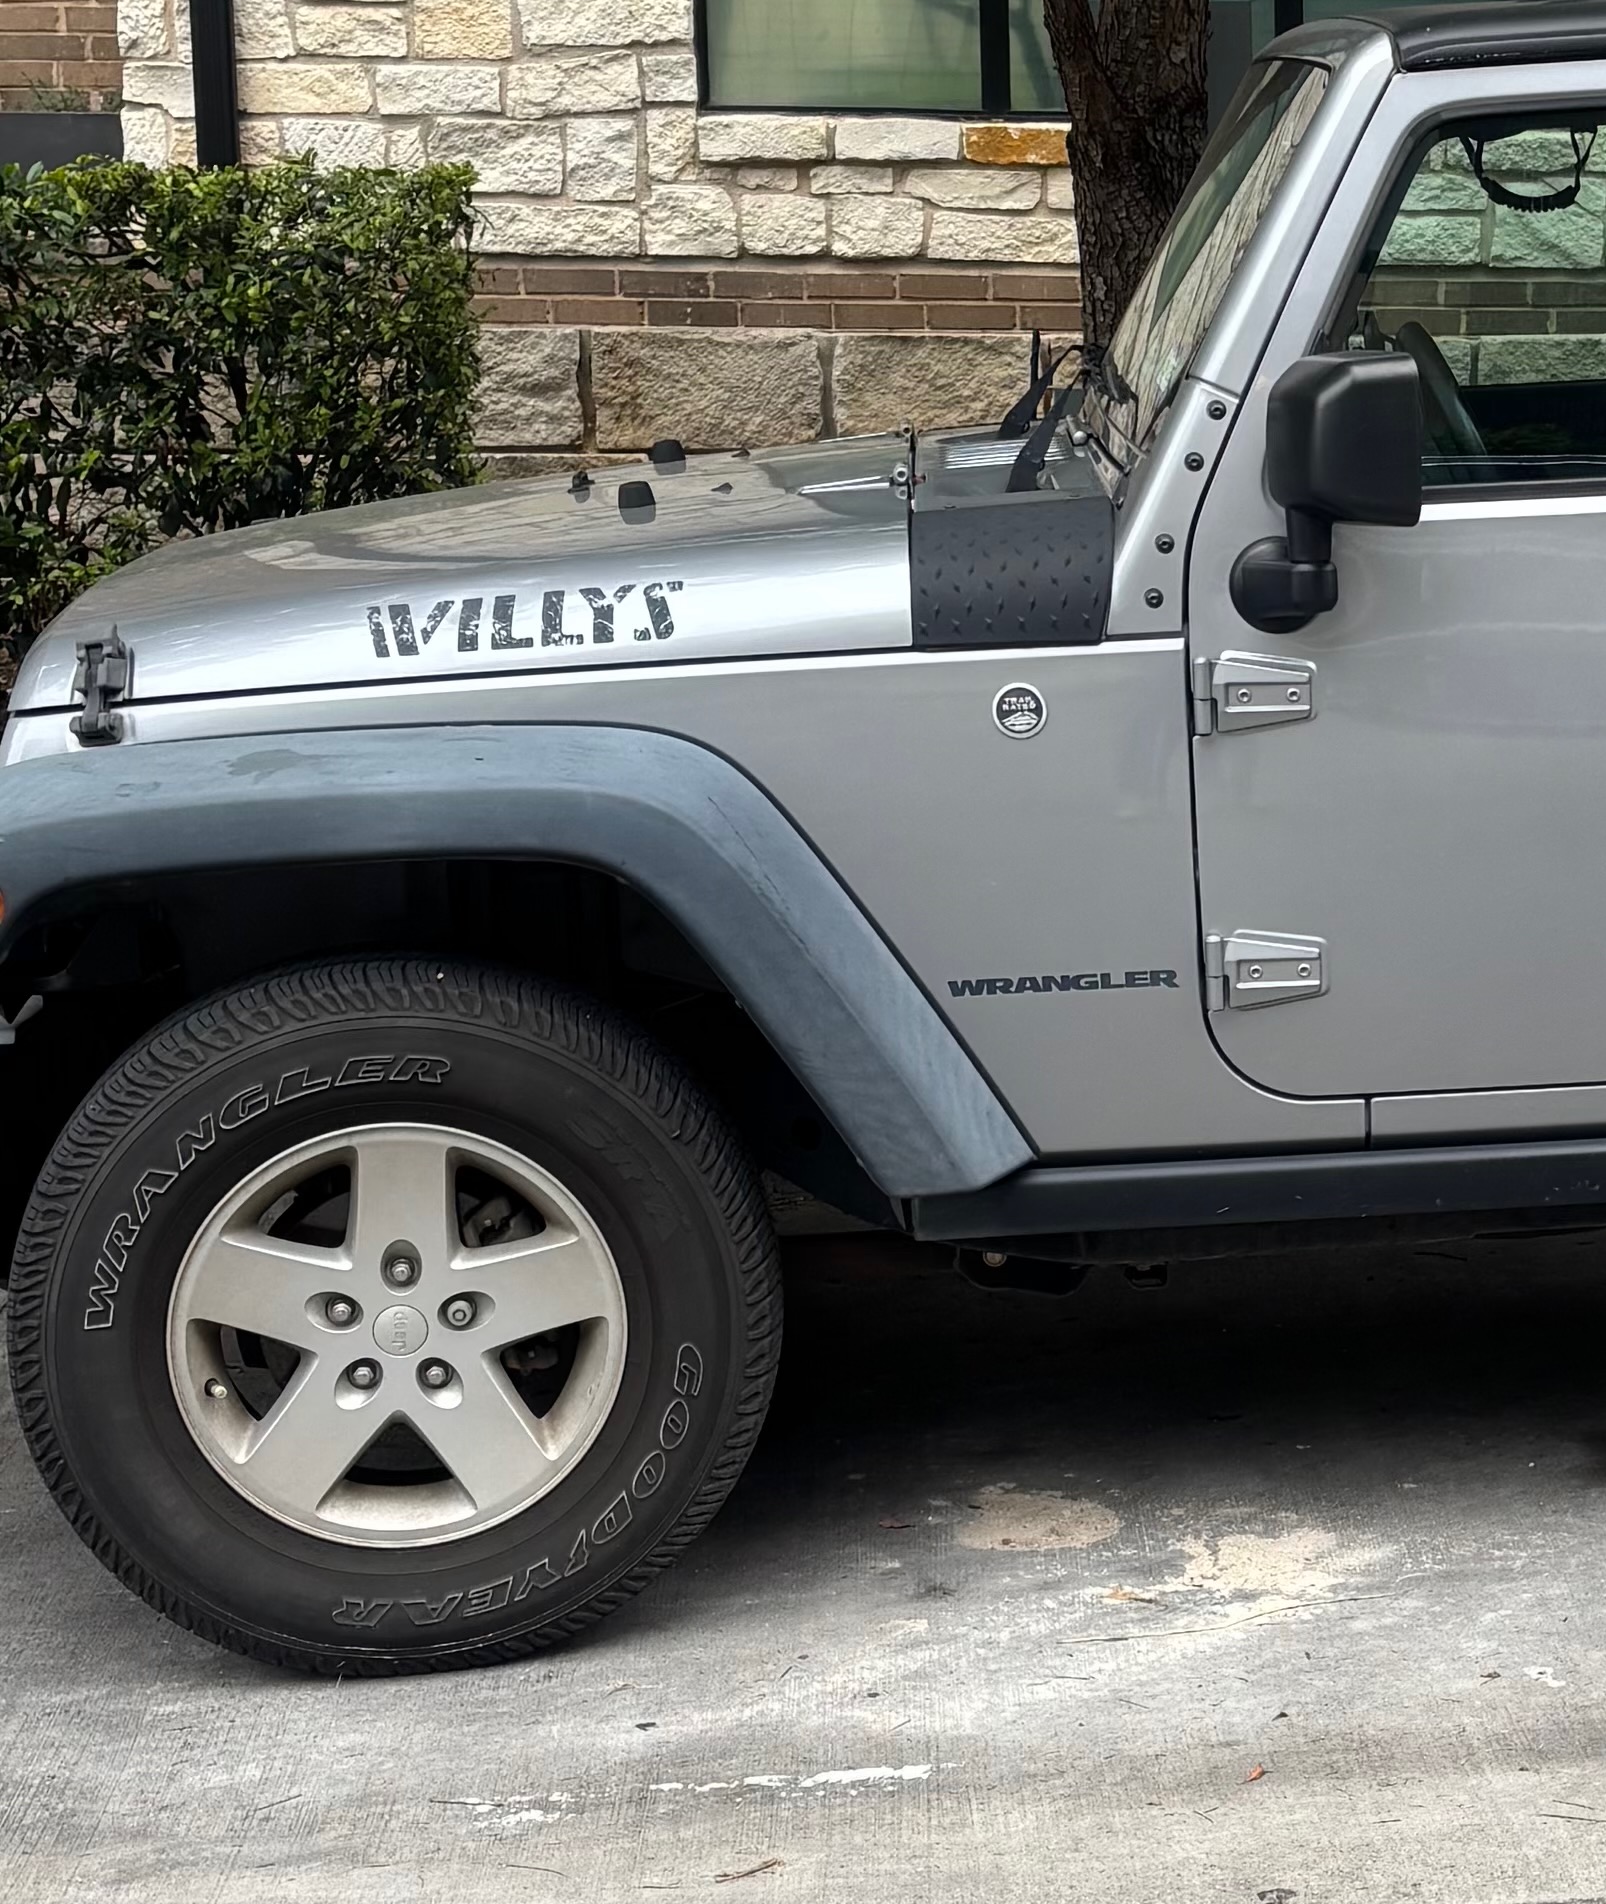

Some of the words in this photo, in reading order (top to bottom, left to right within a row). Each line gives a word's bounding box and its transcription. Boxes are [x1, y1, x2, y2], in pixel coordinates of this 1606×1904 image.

[366, 580, 684, 659] WILLYS
[948, 969, 1179, 998] WRANGLER
[84, 1054, 452, 1331] WRANGLER
[332, 1342, 702, 1630] GOODYEAR
